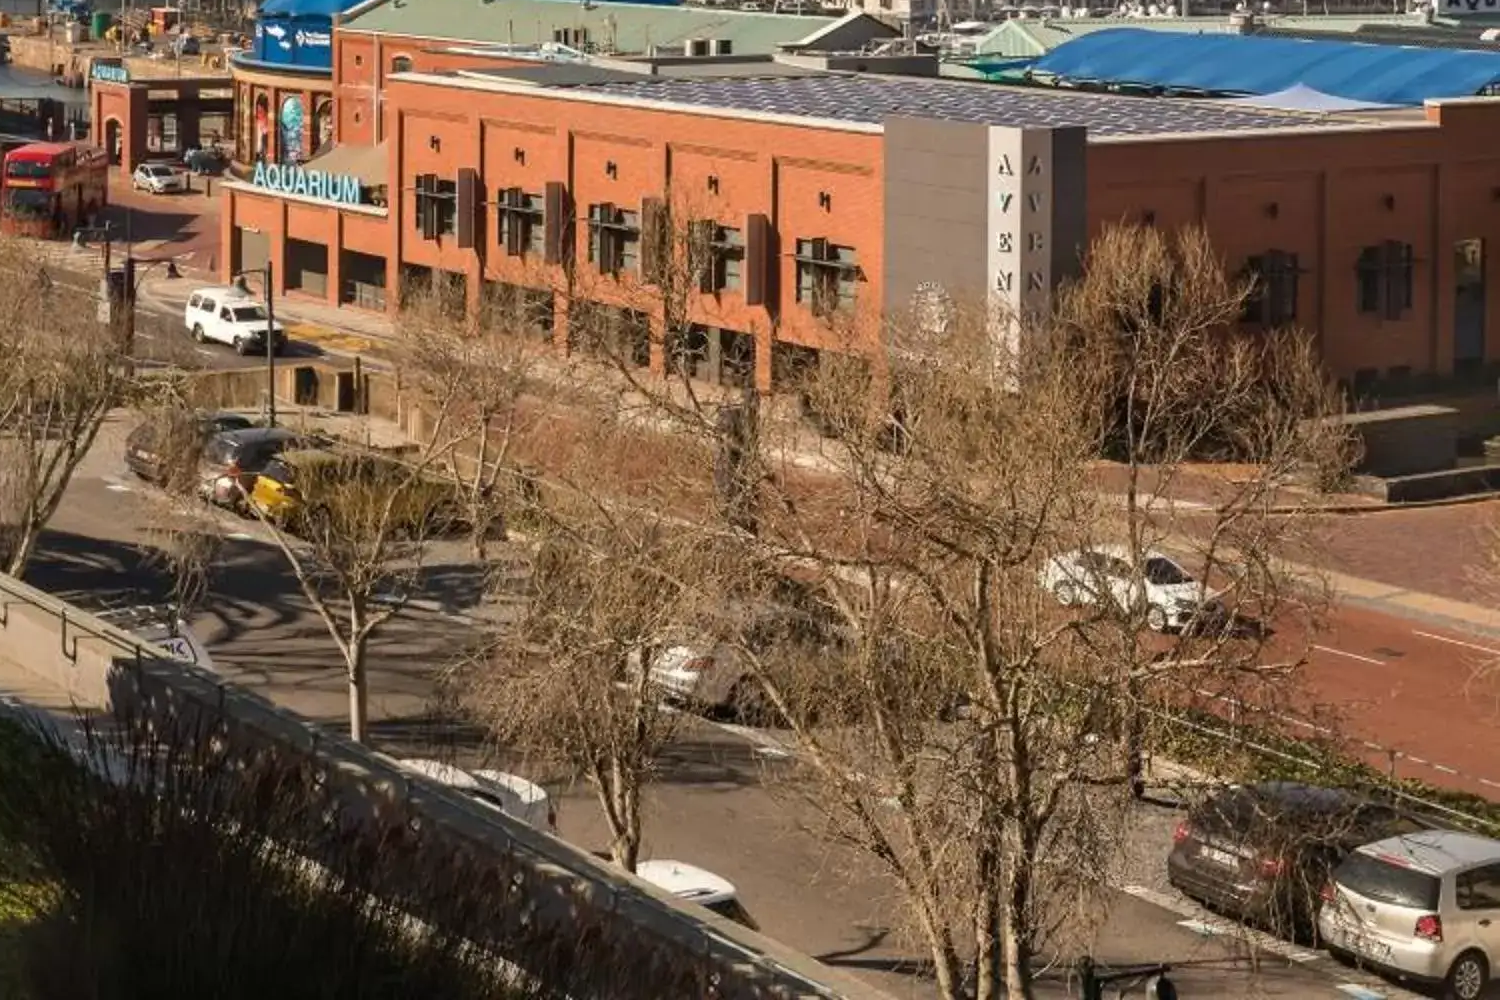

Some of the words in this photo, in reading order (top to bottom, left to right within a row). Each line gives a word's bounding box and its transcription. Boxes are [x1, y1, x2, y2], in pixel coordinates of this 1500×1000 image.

[253, 160, 361, 205] AQUARIUM
[995, 153, 1015, 328] AVEN
[1026, 155, 1045, 328] AVEN
